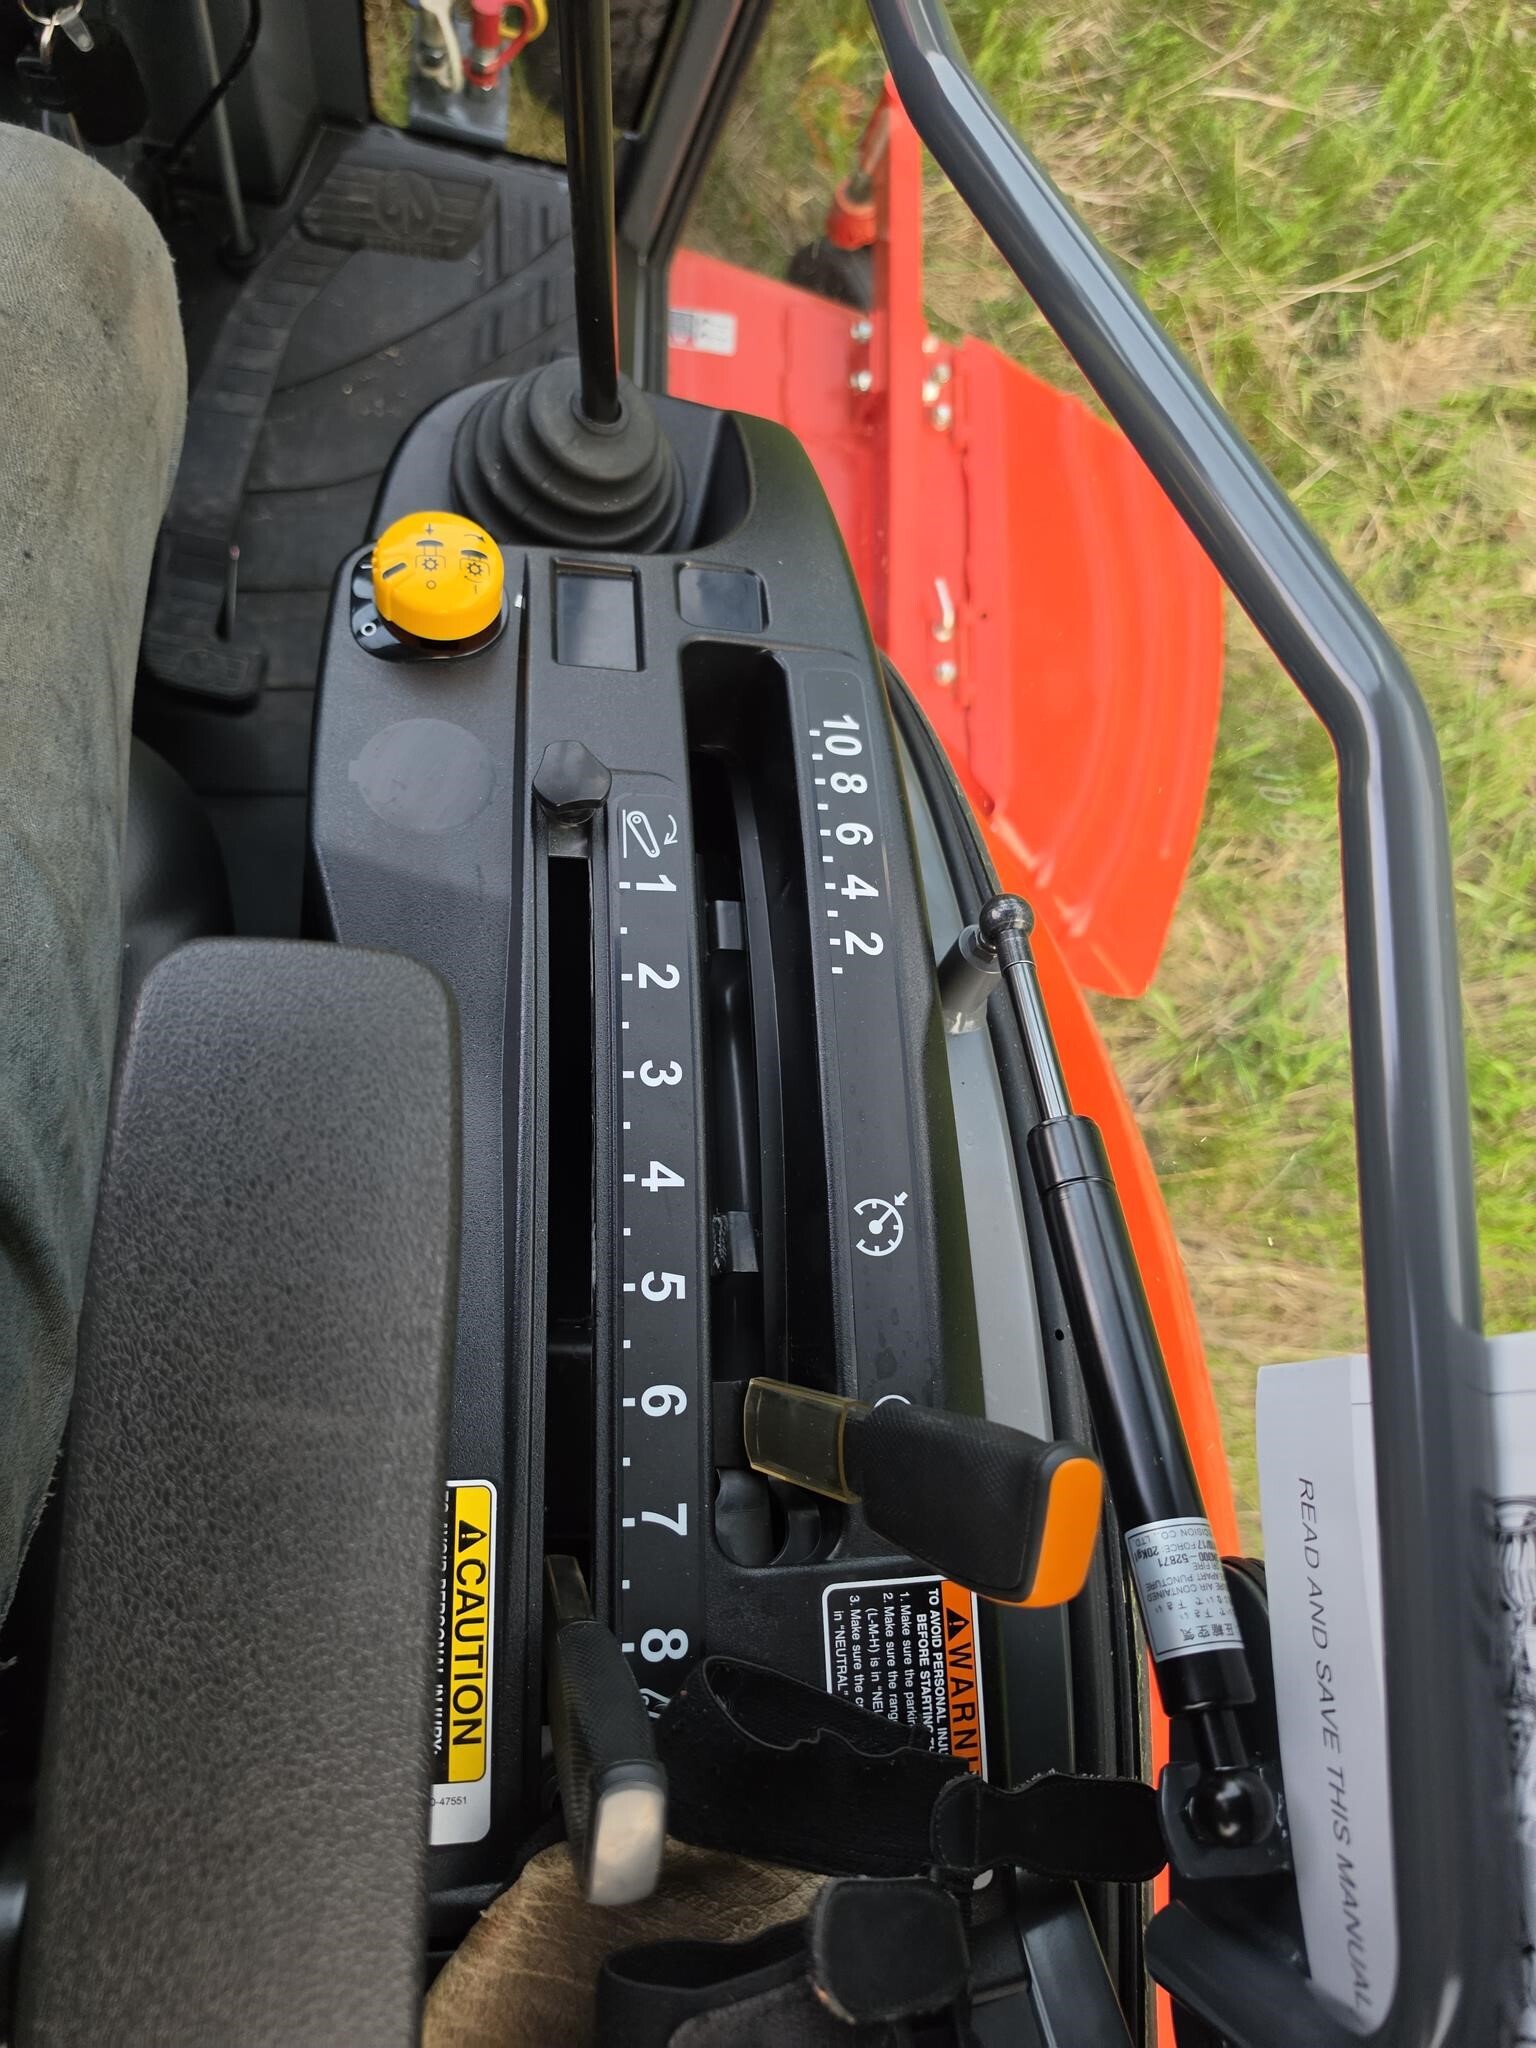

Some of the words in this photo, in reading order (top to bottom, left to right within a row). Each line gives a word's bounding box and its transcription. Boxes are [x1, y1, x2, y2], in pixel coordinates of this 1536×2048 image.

[823, 714, 863, 757] 10
[830, 772, 868, 795] 8
[834, 821, 874, 847] 6
[636, 874, 677, 892] 1
[840, 874, 879, 900] 4
[844, 931, 884, 957] 2
[638, 962, 680, 989] 2
[639, 1060, 683, 1087] 3
[641, 1160, 685, 1192] 4
[641, 1271, 686, 1302] 5
[641, 1384, 688, 1417] 6
[641, 1503, 688, 1536] 7
[1180, 1527, 1209, 1537] CISION
[1298, 1477, 1320, 1569] READ
[850, 1595, 860, 1605] 3.
[883, 1592, 894, 1603] 2.
[900, 1592, 910, 1601] 1.
[929, 1588, 939, 1605] TO
[834, 1610, 844, 1620] in
[850, 1609, 861, 1640] Make
[884, 1606, 895, 1637] Make
[900, 1605, 911, 1635] Make
[1306, 1576, 1329, 1650] AND
[866, 1608, 880, 1653] (L-M-H)
[916, 1614, 929, 1666] BEFORE
[930, 1610, 942, 1648] AVOID
[452, 1558, 487, 1746] CAUTION
[640, 1628, 689, 1662] 8
[852, 1646, 861, 1670] sure
[886, 1642, 896, 1667] sure
[903, 1640, 912, 1665] sure
[870, 1658, 880, 1667] is
[854, 1675, 865, 1693] the
[871, 1672, 882, 1682] in
[888, 1671, 899, 1689] the
[904, 1670, 915, 1688] the
[933, 1652, 946, 1723] PERSONAL
[888, 1694, 898, 1722] rang
[904, 1692, 917, 1727] parkin
[949, 1642, 979, 1760] WARN
[1315, 1659, 1341, 1754] SAVE
[937, 1727, 948, 1754] INJU
[1326, 1765, 1351, 1846] THIS
[1336, 1852, 1372, 2010] MANUAL
